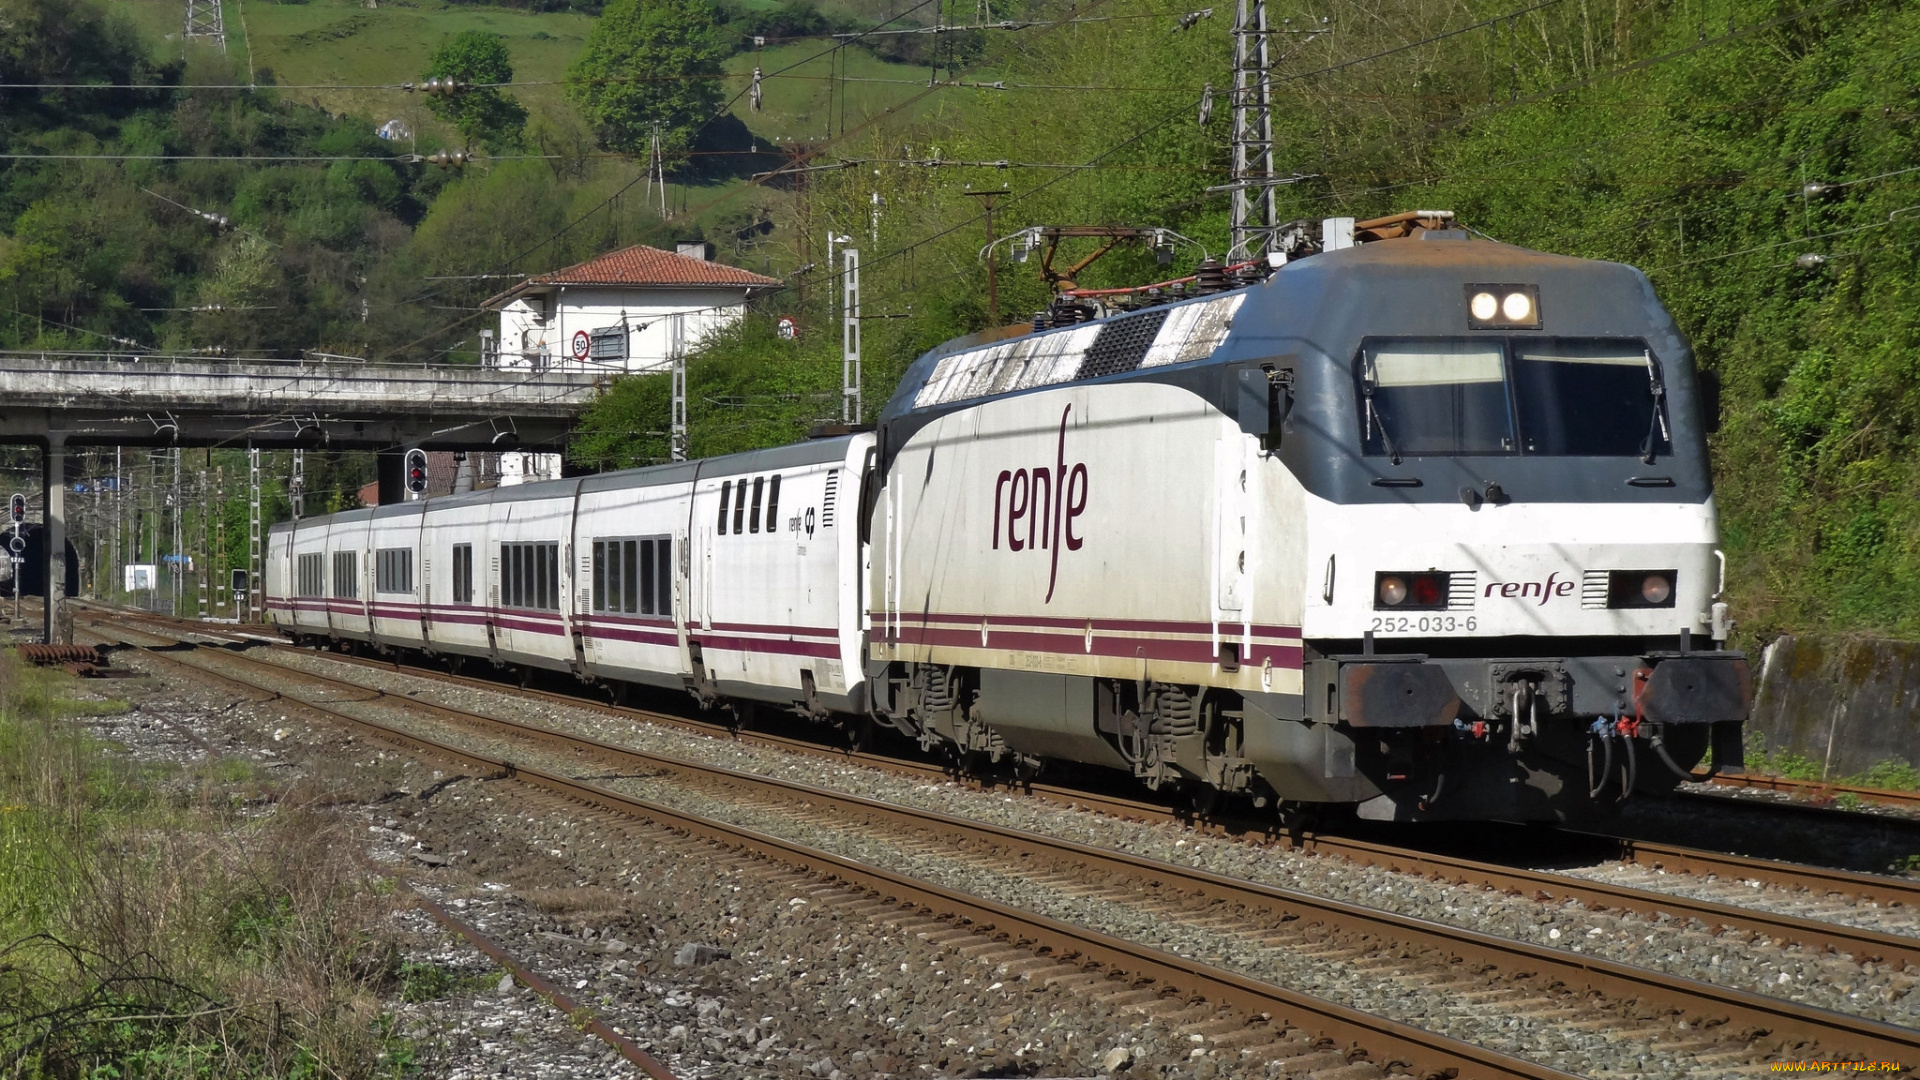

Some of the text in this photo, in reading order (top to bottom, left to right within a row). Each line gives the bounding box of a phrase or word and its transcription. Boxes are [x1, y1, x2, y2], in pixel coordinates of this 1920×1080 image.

[575, 340, 586, 350] 50
[992, 402, 1088, 604] renfe
[1484, 571, 1575, 606] renfe
[1371, 616, 1477, 632] 252-033-6
